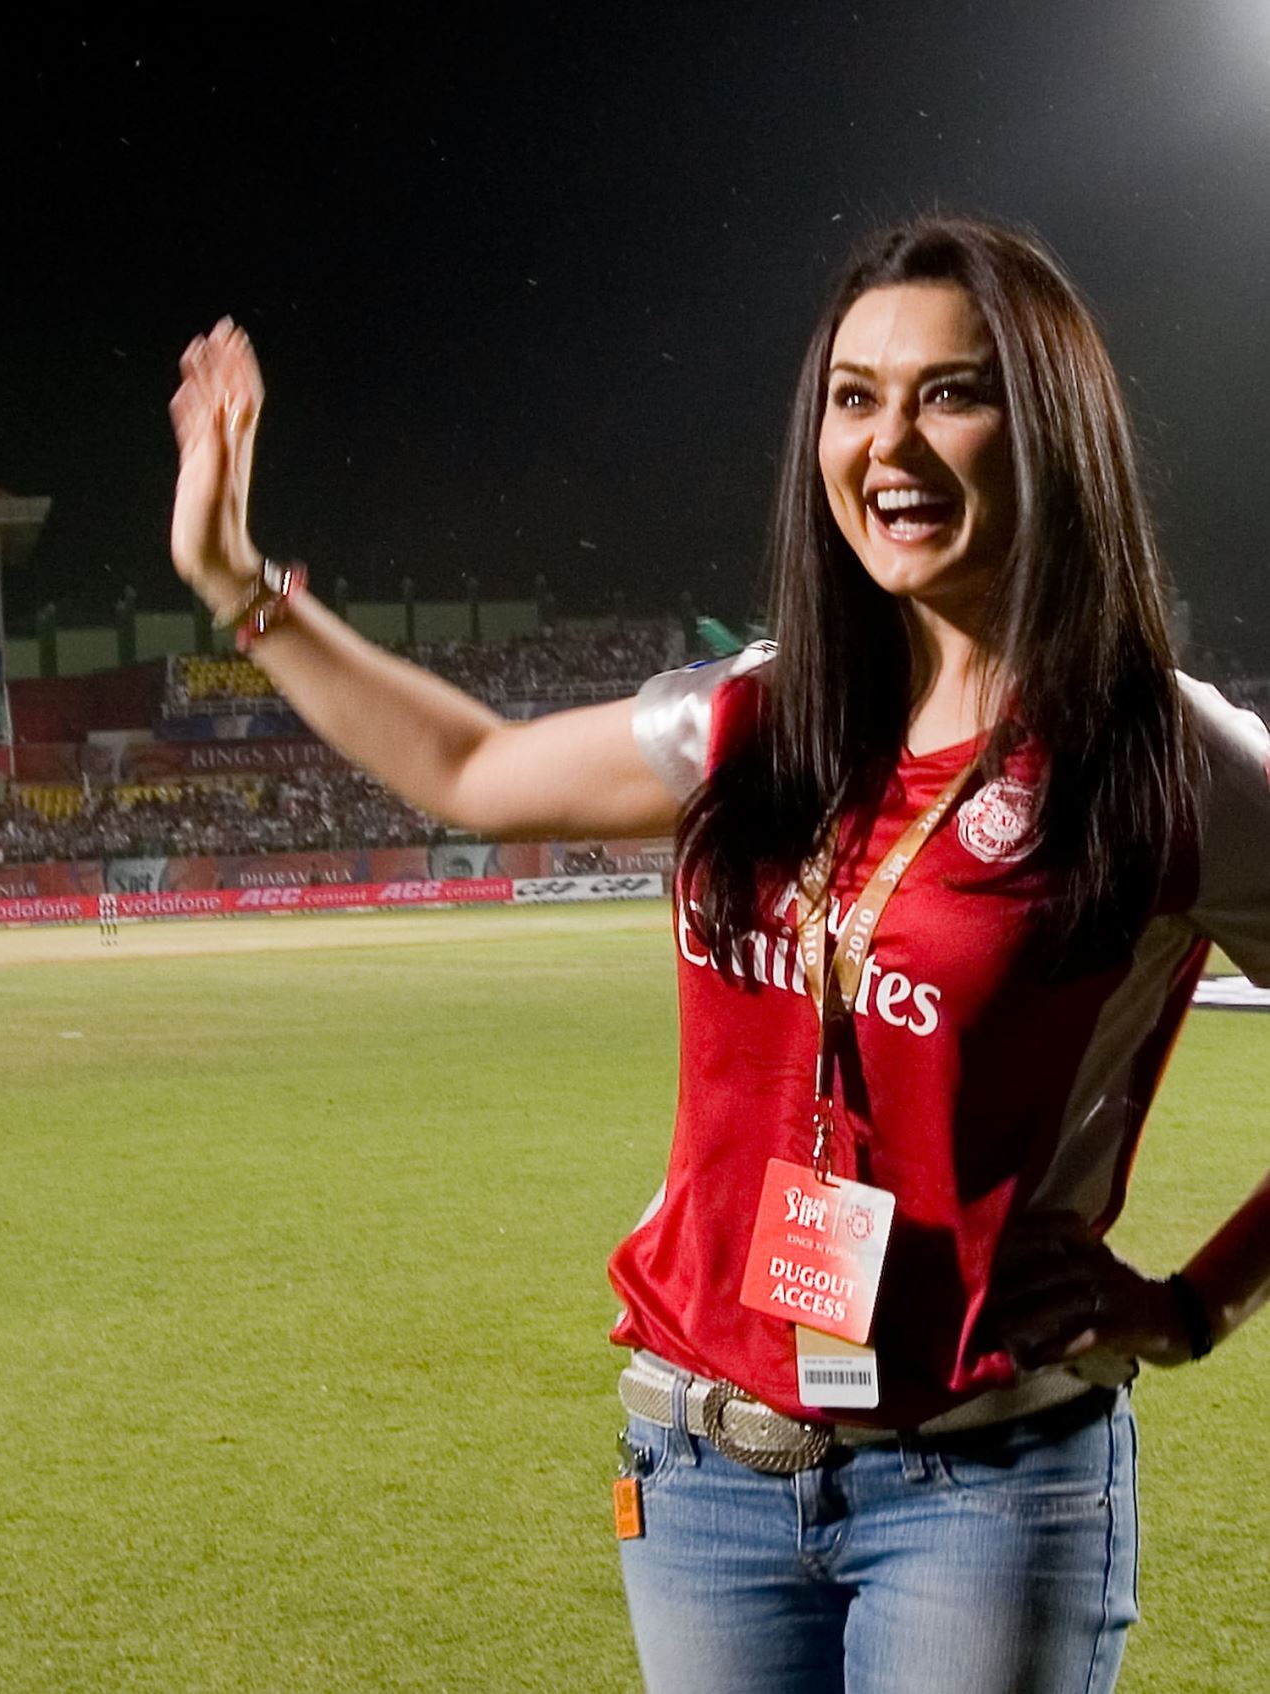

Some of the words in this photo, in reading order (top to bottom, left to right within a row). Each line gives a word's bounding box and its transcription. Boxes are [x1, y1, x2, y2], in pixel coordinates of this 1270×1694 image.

[190, 746, 266, 768] KINGS
[121, 895, 221, 914] vodafone
[844, 907, 874, 966] 2010
[678, 892, 942, 1037] Emirtes
[769, 1256, 858, 1300] DUGOUT
[770, 1282, 847, 1322] ACCESS
